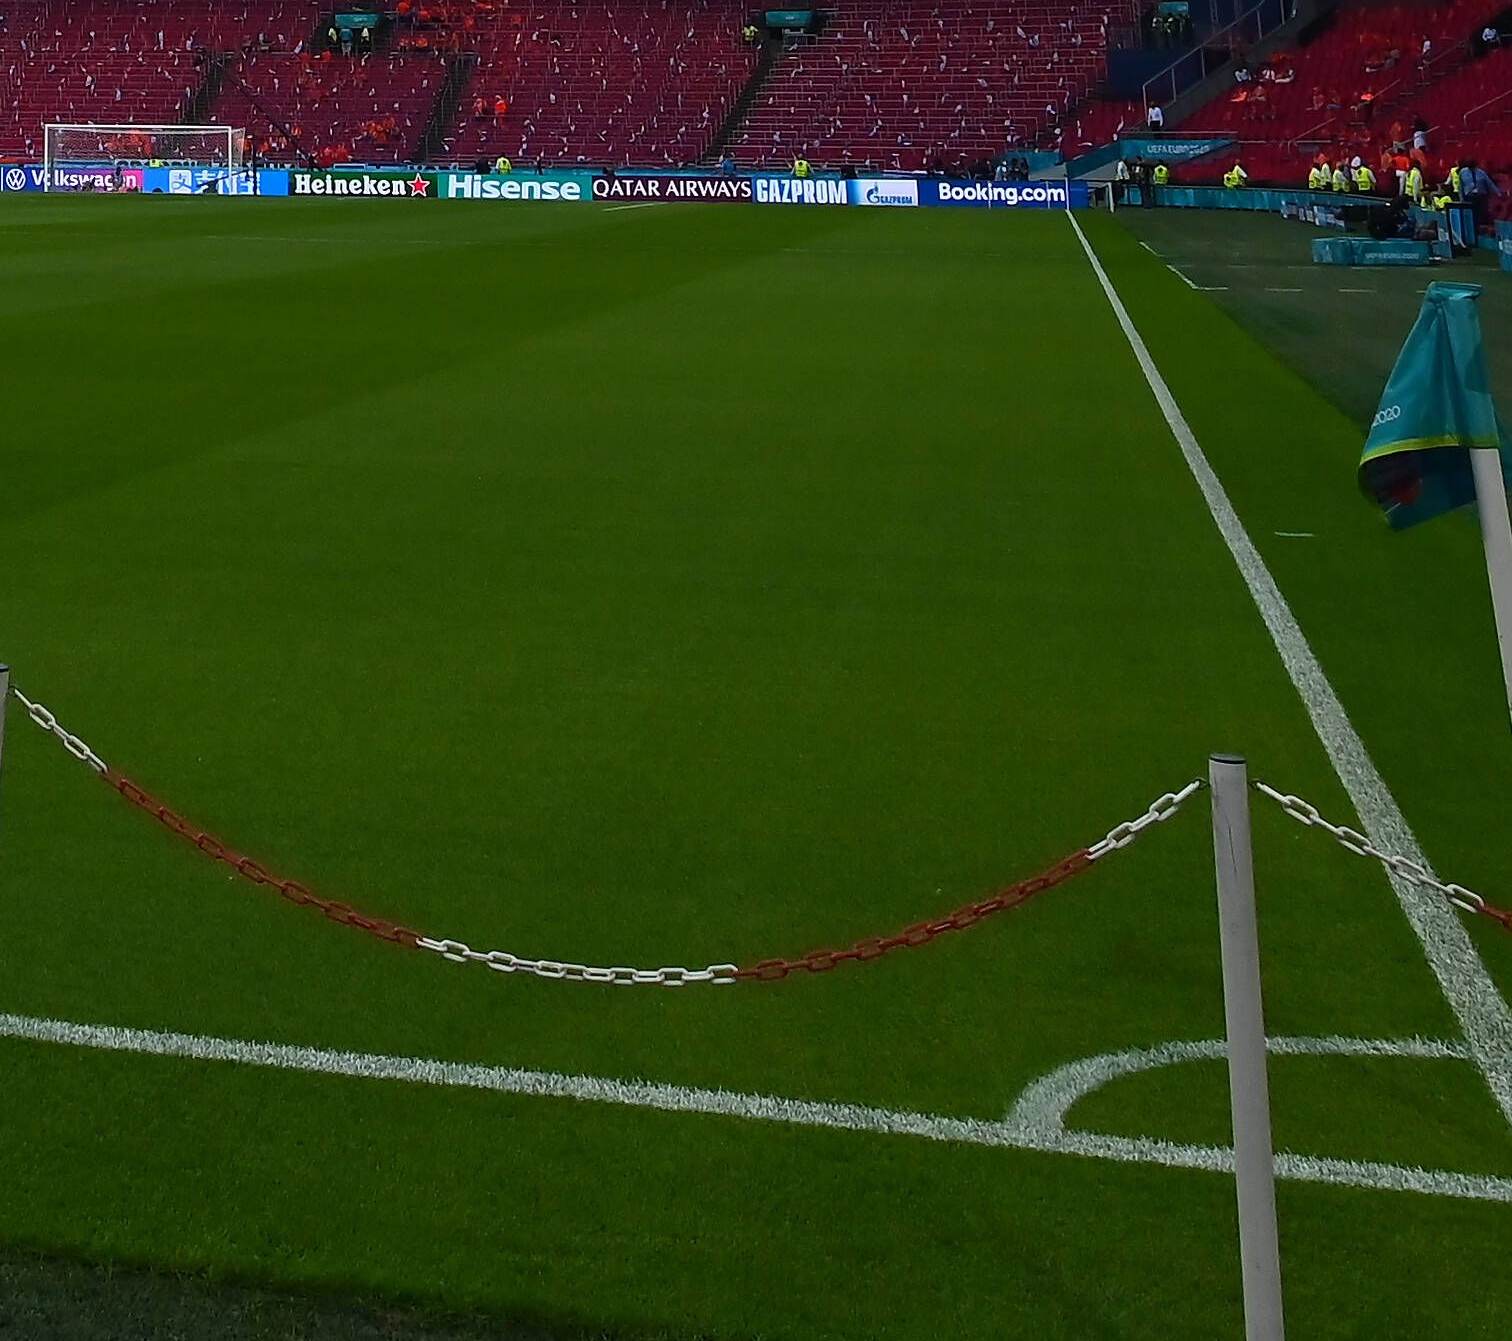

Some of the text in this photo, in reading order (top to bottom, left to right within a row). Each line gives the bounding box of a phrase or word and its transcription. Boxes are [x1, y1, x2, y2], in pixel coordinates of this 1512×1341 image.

[294, 174, 407, 196] Heineken
[447, 174, 581, 200] Hisense
[592, 179, 752, 197] QATAR AIRWAYS
[756, 179, 848, 204] GAZPROM
[938, 182, 1066, 204] Booking.com
